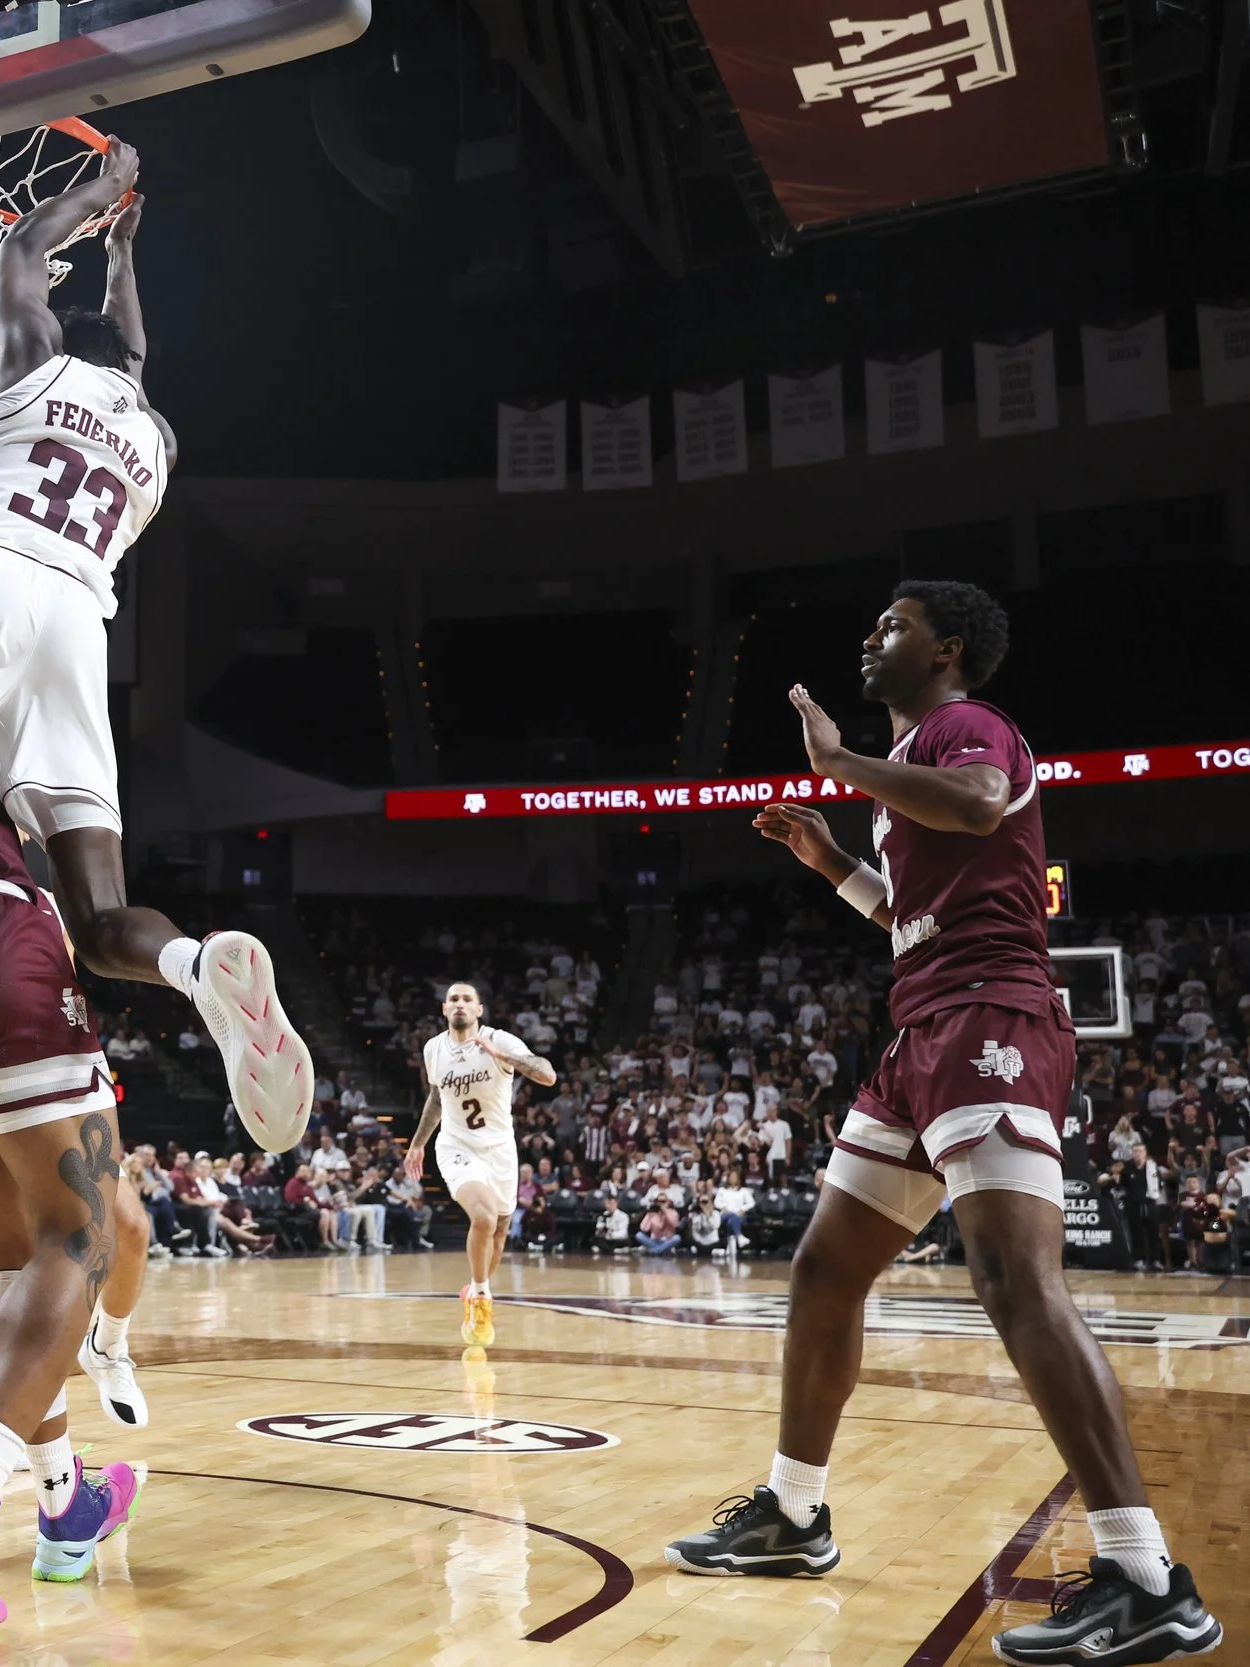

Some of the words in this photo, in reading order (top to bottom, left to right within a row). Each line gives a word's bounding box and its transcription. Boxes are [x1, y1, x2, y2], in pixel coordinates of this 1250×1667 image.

[45, 400, 153, 488] FEDERIKO
[8, 438, 128, 561] 33
[520, 789, 647, 811] TOGETHER,
[654, 788, 690, 806] WE
[699, 782, 773, 805] STAND
[781, 779, 812, 799] AS
[820, 778, 837, 796] A
[441, 1068, 492, 1098] Aggies
[462, 1098, 486, 1130] 2
[1064, 1199, 1098, 1211] ELLS
